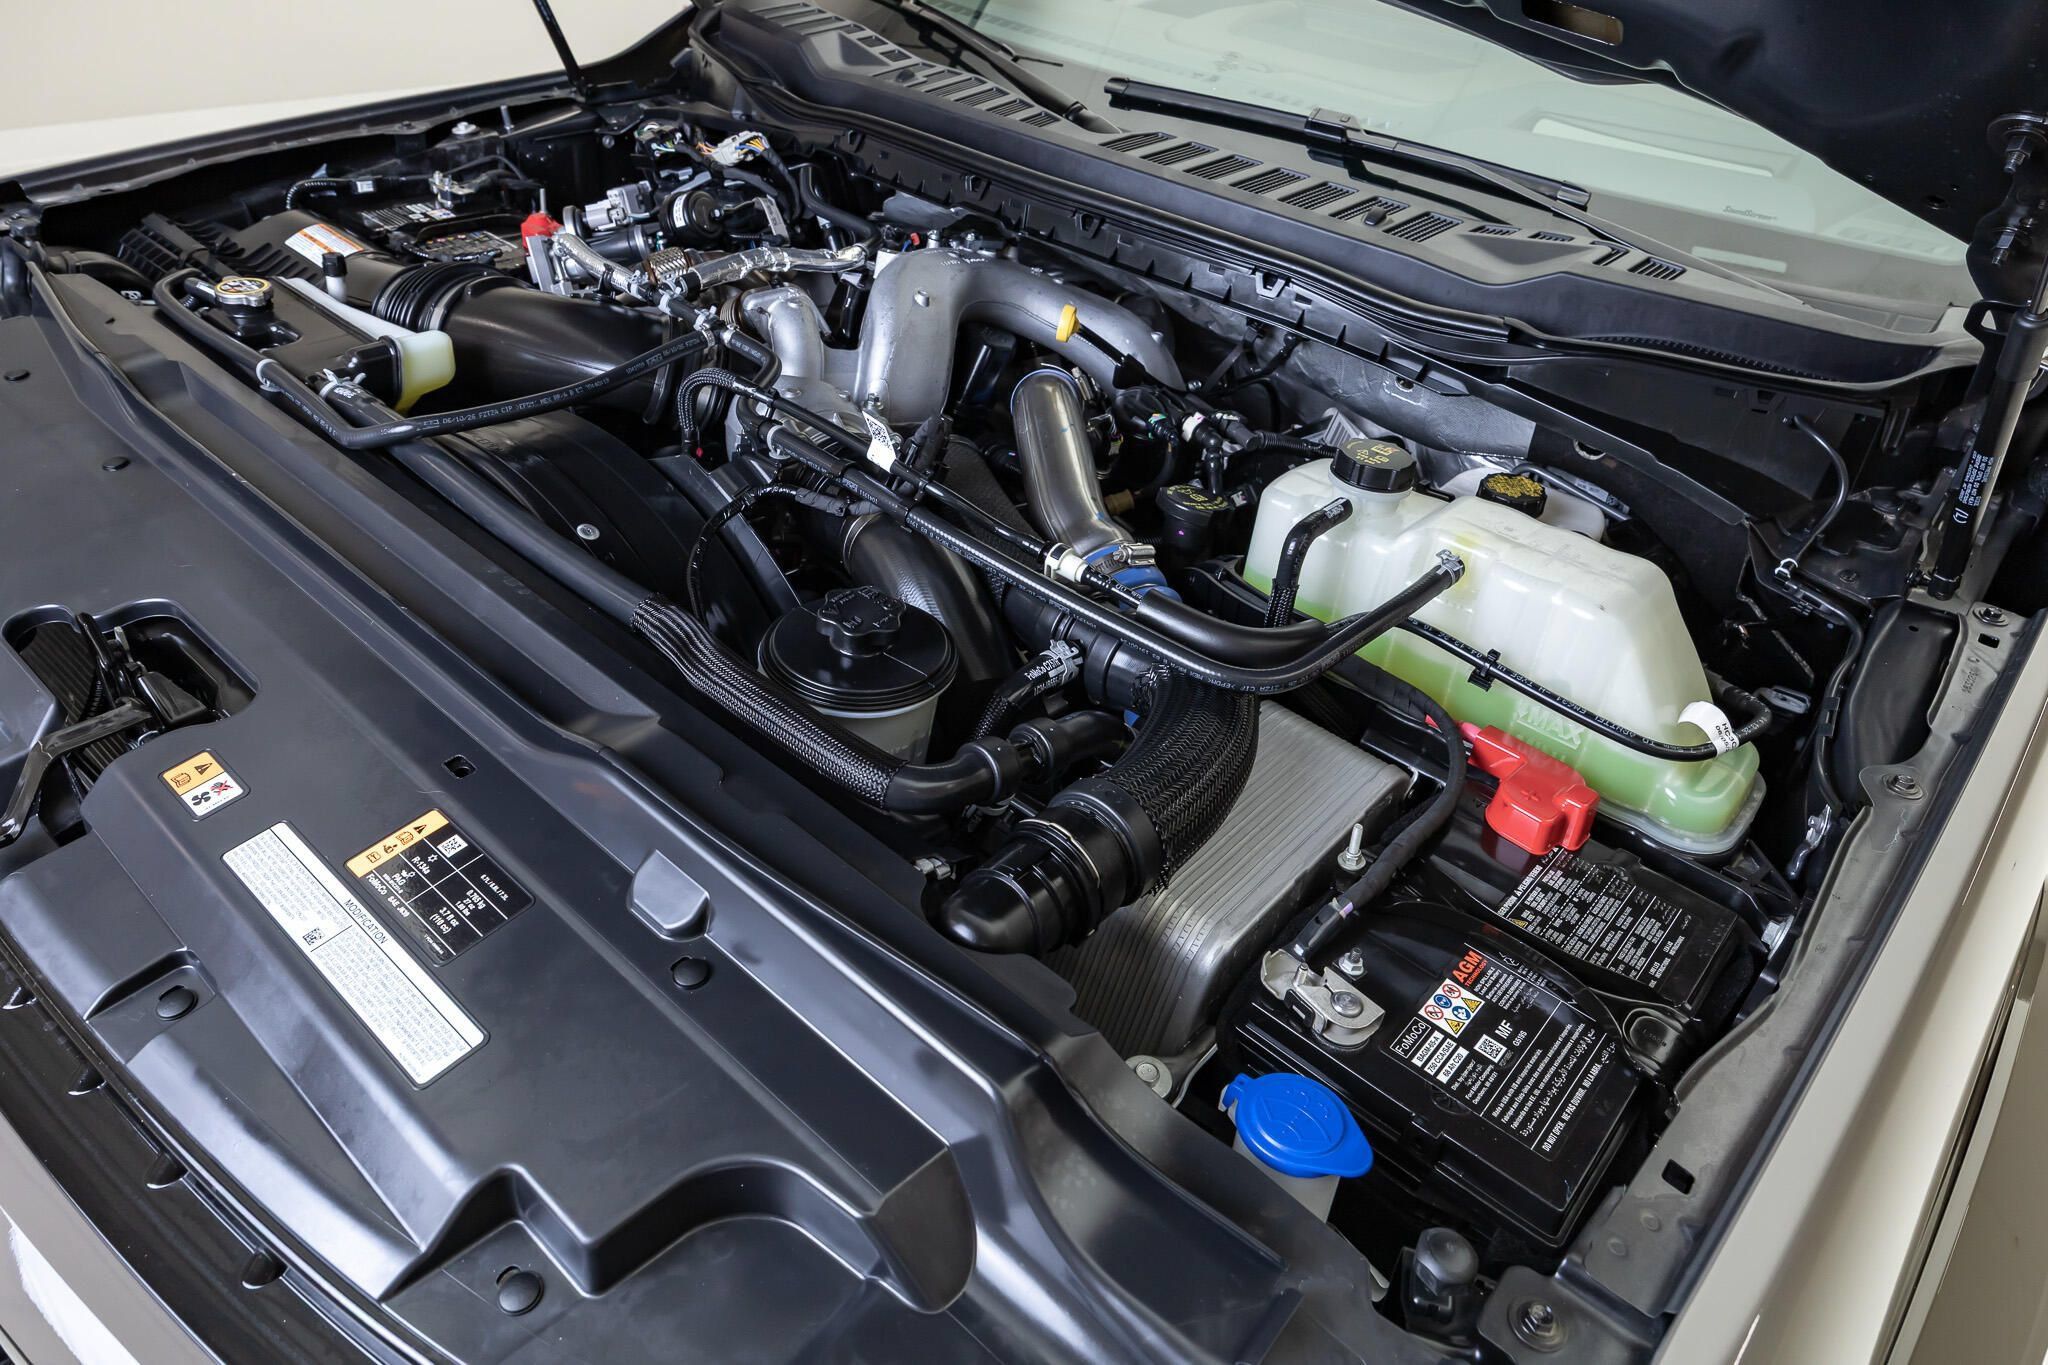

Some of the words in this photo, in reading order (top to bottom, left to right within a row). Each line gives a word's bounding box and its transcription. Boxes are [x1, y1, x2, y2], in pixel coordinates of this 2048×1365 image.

[391, 872, 406, 885] PAG
[386, 895, 400, 907] SAE
[342, 897, 389, 945] MODIFICATION
[1452, 951, 1481, 982] AGM
[1464, 958, 1488, 986] TECHNOLOGY
[1495, 1019, 1512, 1038] MF
[1395, 1019, 1425, 1056] FoMoCo
[1416, 1034, 1439, 1063] BAGM-65-A
[1426, 1060, 1438, 1073] 750
[1433, 1039, 1454, 1064] CCA/SAE
[1447, 1061, 1456, 1071] Ah
[1581, 1078, 1592, 1088] NO
[1585, 1073, 1595, 1081] LA
[1565, 1103, 1576, 1114] PAS
[1560, 1111, 1571, 1121] NE
[1552, 1120, 1565, 1135] OPEN.
[1546, 1132, 1557, 1144] NOT
[1541, 1141, 1551, 1151] DO
